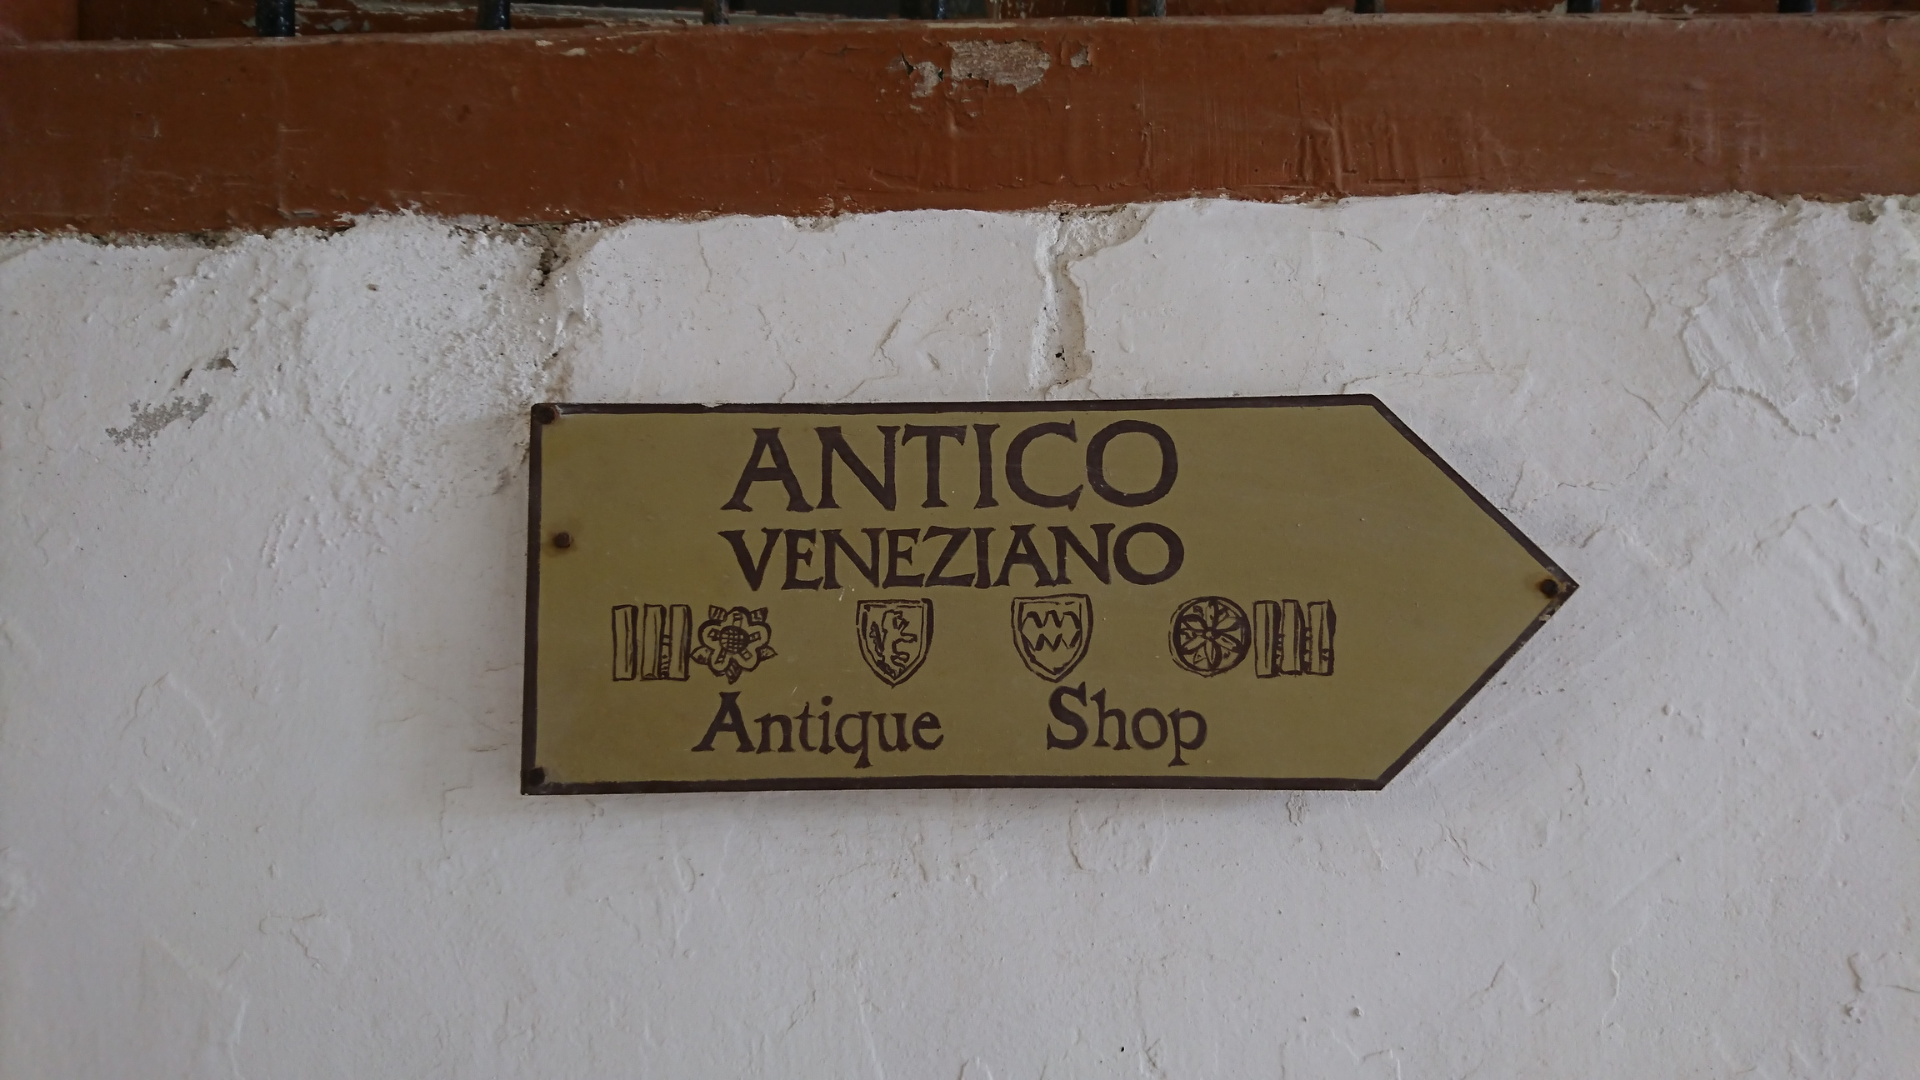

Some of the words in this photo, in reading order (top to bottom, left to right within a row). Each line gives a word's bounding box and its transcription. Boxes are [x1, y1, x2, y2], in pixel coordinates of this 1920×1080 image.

[720, 418, 1178, 512] ANTICO
[717, 521, 1184, 591] VENEZIANO
[690, 690, 944, 769] Antique
[1046, 681, 1207, 767] Shop
